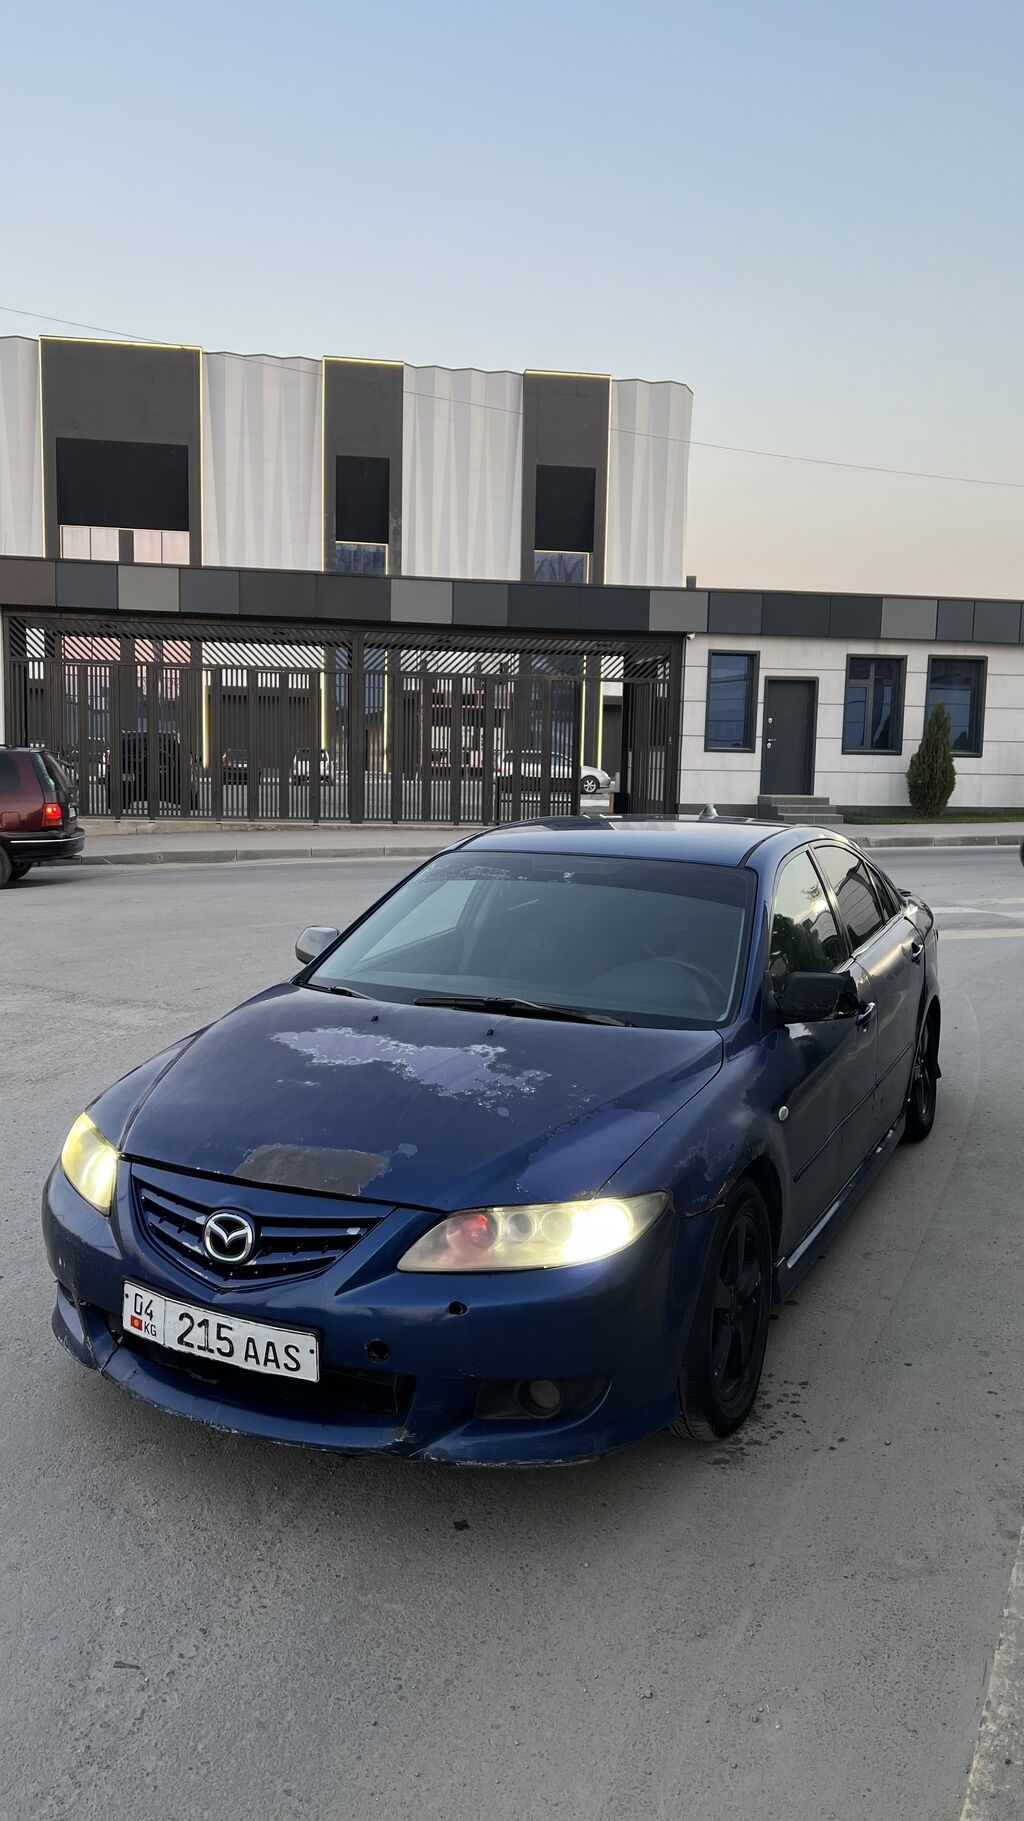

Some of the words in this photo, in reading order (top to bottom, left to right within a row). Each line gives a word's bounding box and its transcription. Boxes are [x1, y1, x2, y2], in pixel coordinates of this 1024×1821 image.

[134, 1293, 153, 1321] 04
[144, 1321, 157, 1337] KG
[177, 1312, 234, 1358] 215
[244, 1336, 301, 1372] AAS
